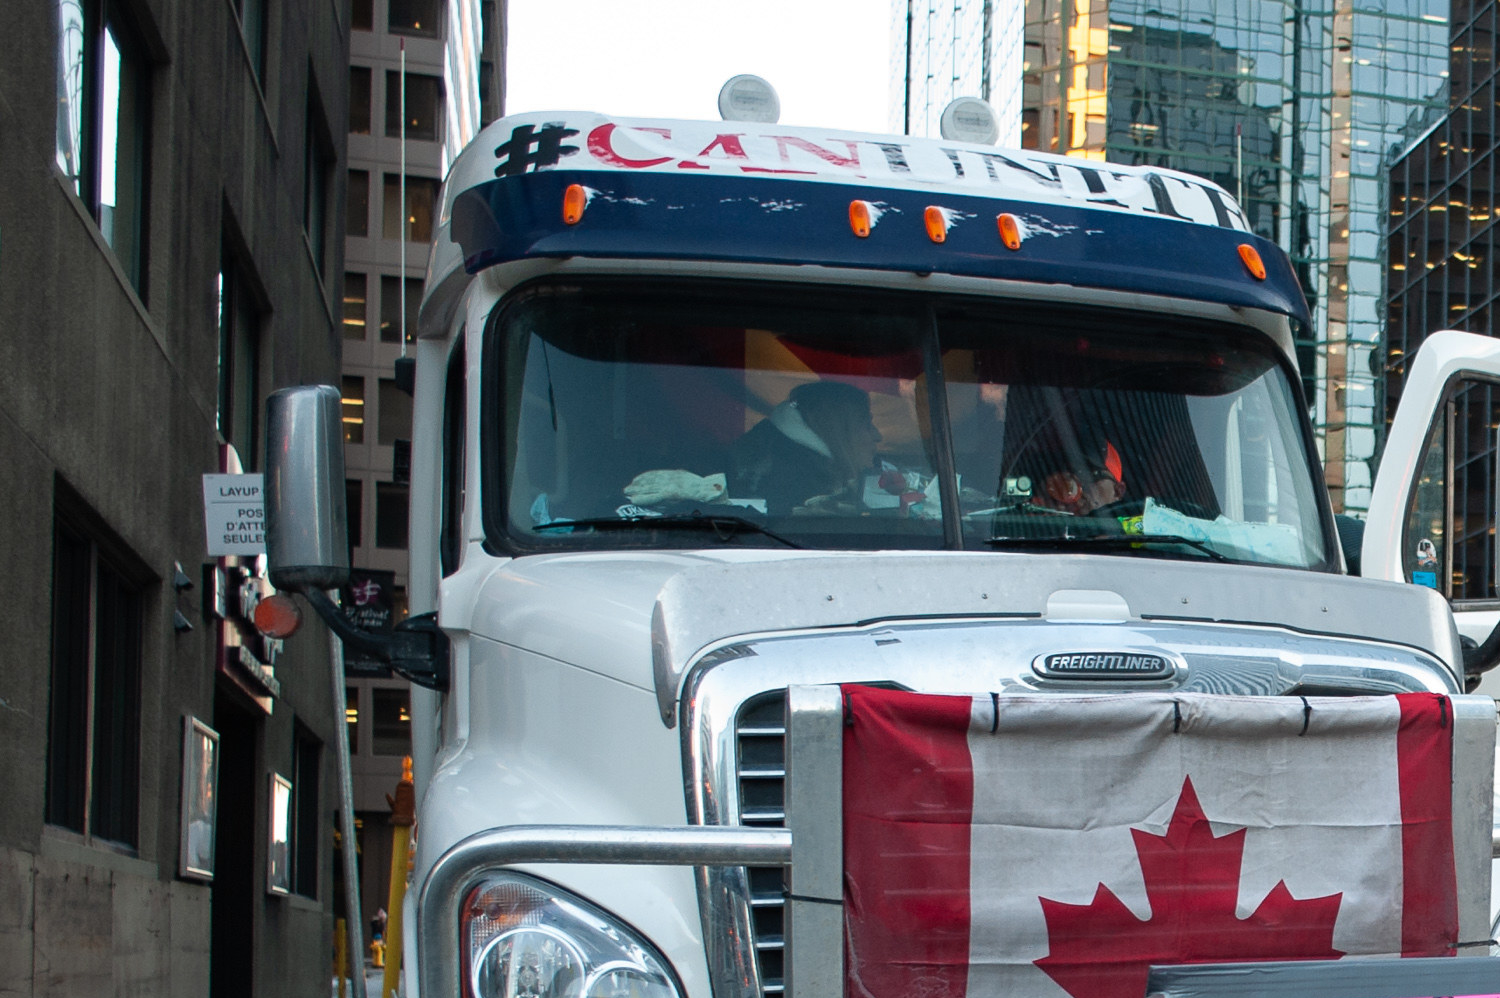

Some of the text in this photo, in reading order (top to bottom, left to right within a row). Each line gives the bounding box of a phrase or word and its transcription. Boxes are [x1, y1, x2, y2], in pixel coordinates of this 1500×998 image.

[220, 487, 259, 496] LAYUP
[223, 534, 265, 544] SEULE
[1050, 655, 1161, 670] FREIGHTLINER
